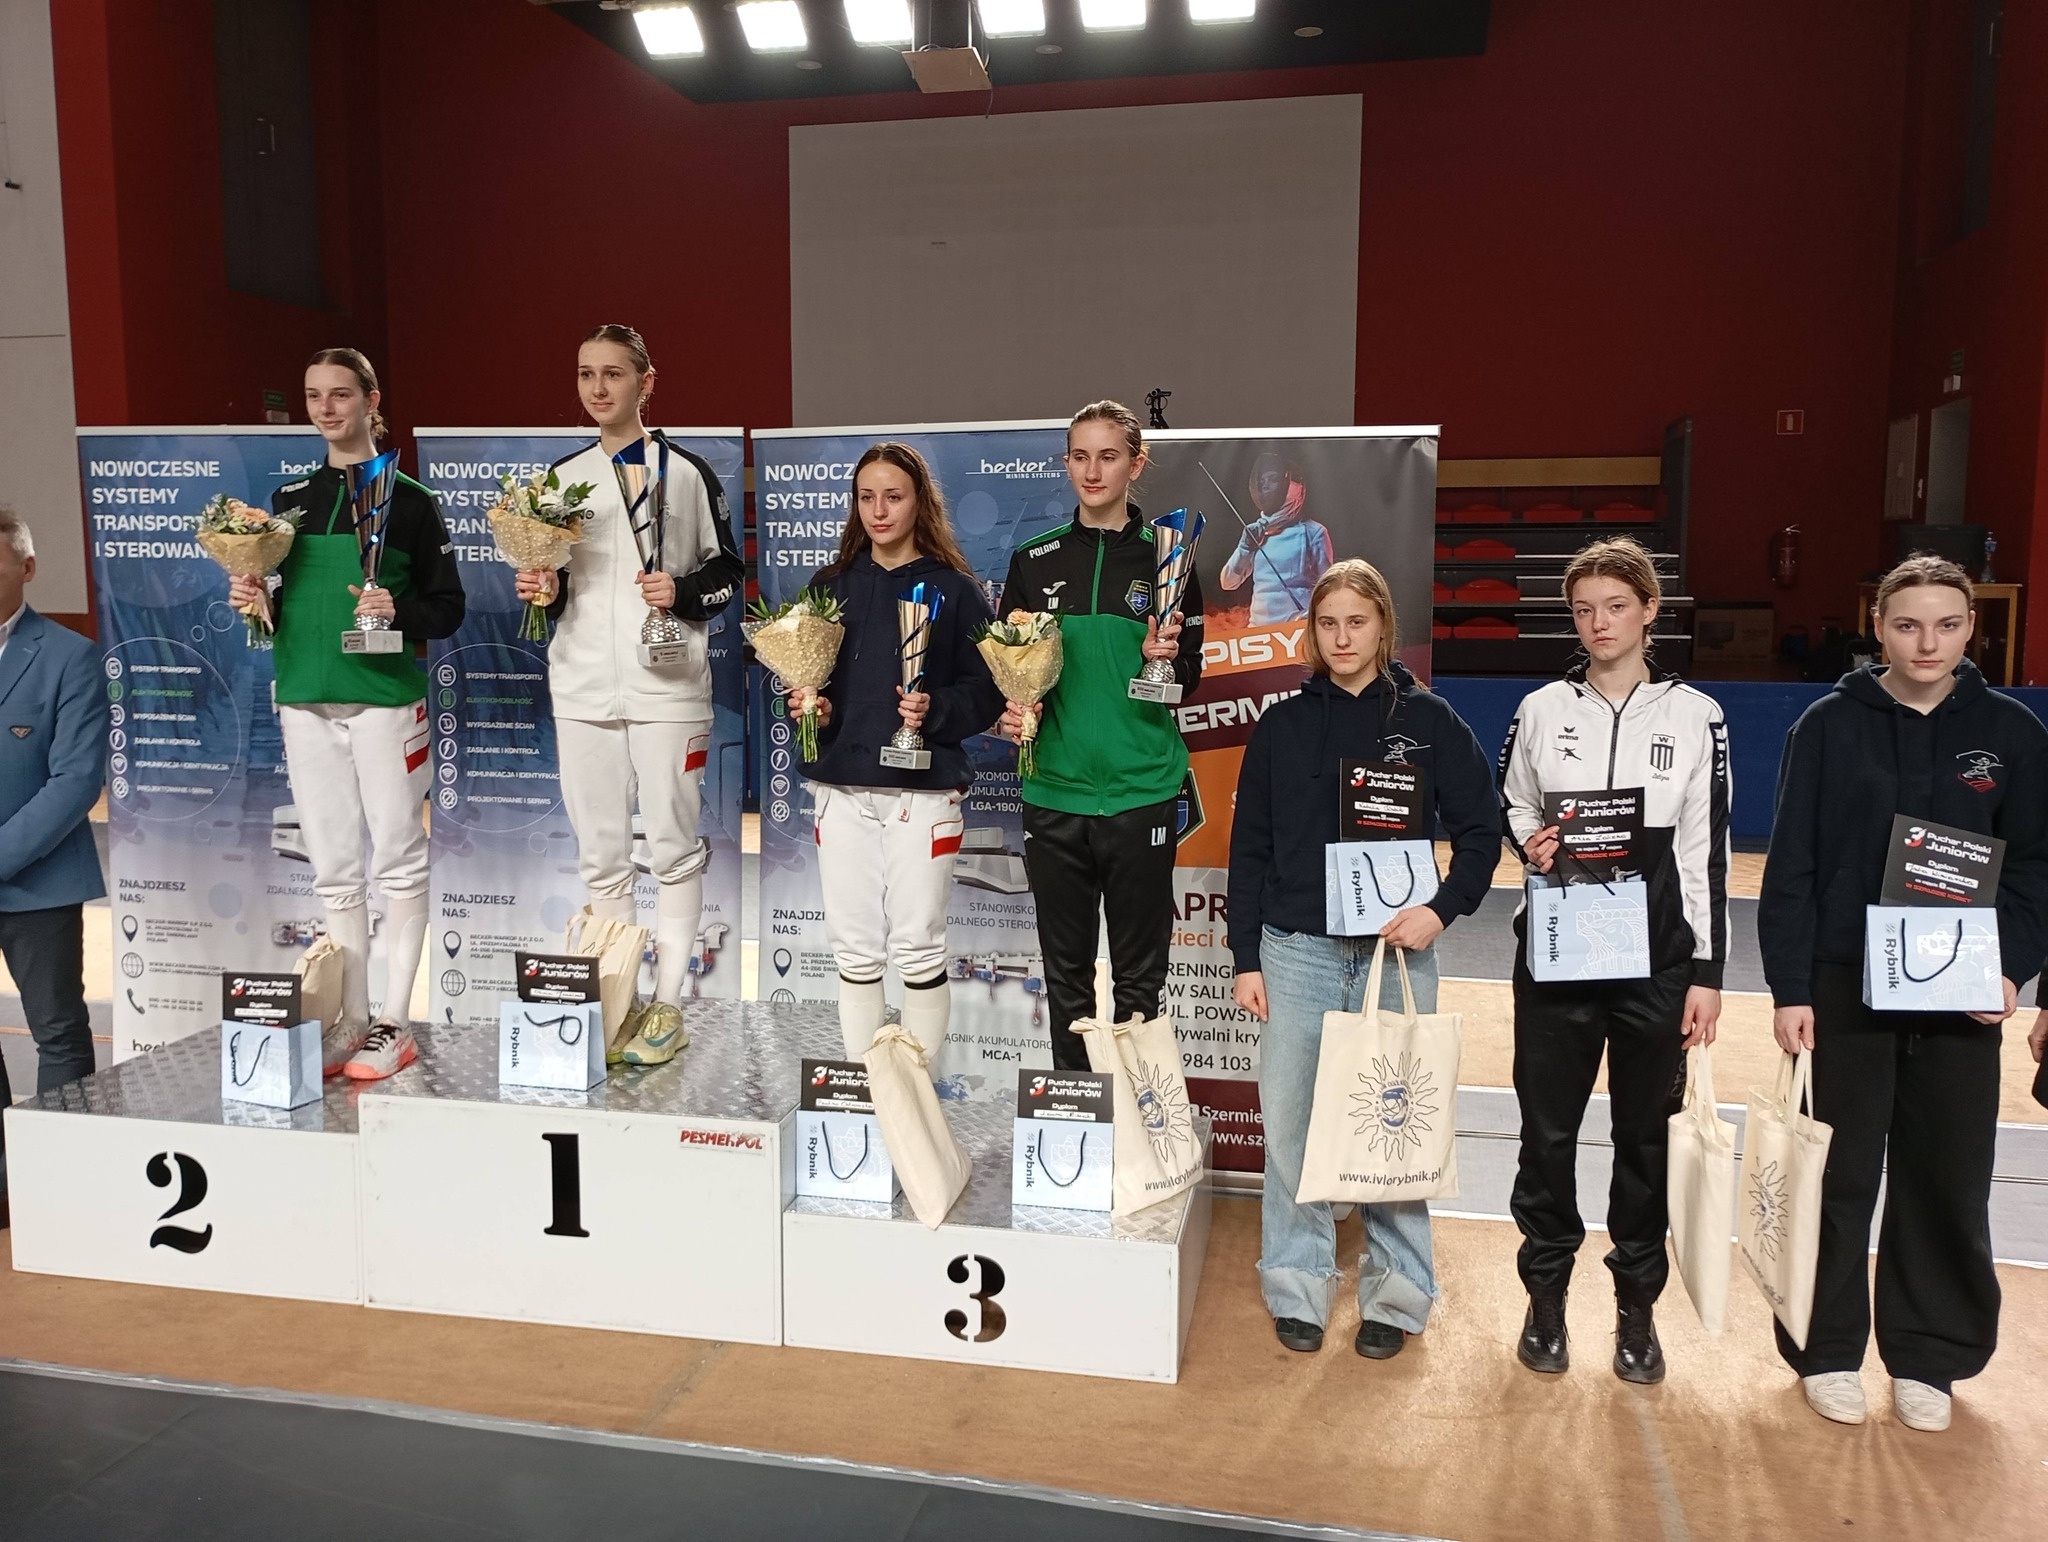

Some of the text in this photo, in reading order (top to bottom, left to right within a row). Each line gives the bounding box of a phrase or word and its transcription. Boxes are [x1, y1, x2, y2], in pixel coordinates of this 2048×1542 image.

[90, 460, 220, 478] NOWOCZESNE
[981, 457, 1047, 474] becker
[1005, 472, 1030, 480] MINING
[92, 487, 179, 505] SYSTEMY
[1028, 539, 1062, 560] POLAND
[766, 550, 771, 567] I
[1047, 597, 1059, 610] LM
[1366, 769, 1416, 783] Puchar Polski
[1366, 778, 1415, 792] Juniorów
[1370, 795, 1394, 804] Dyplom
[1577, 796, 1636, 808] Puchar Polski
[1578, 806, 1636, 818] Juniorów
[1151, 826, 1167, 847] LM
[1584, 826, 1615, 834] Dyplom
[1926, 831, 1992, 855] Puchar Polski
[1925, 841, 1990, 864] Juniorów
[1927, 859, 1960, 873] Dyplom
[442, 892, 516, 906] ZNAJDZIESZ
[1351, 870, 1366, 917] Rybnik
[970, 901, 1036, 916] STANOWISKO
[773, 923, 801, 936] NAS:
[1546, 916, 1559, 963] Rybnik
[1885, 937, 1900, 990] Rybnik
[1167, 983, 1225, 1000] W SALI
[510, 1026, 520, 1069] Rybnik
[982, 1049, 1022, 1063] MCA-1
[1182, 1053, 1252, 1071] 984 103
[1048, 1087, 1102, 1099] Juniorów
[808, 1136, 818, 1180] Rybnik
[1025, 1144, 1035, 1188] Rybnik
[541, 1132, 590, 1238] 1
[1339, 1167, 1442, 1187] www.ivlorybnik.pl
[146, 1151, 213, 1254] 2
[944, 1253, 1007, 1343] 3
